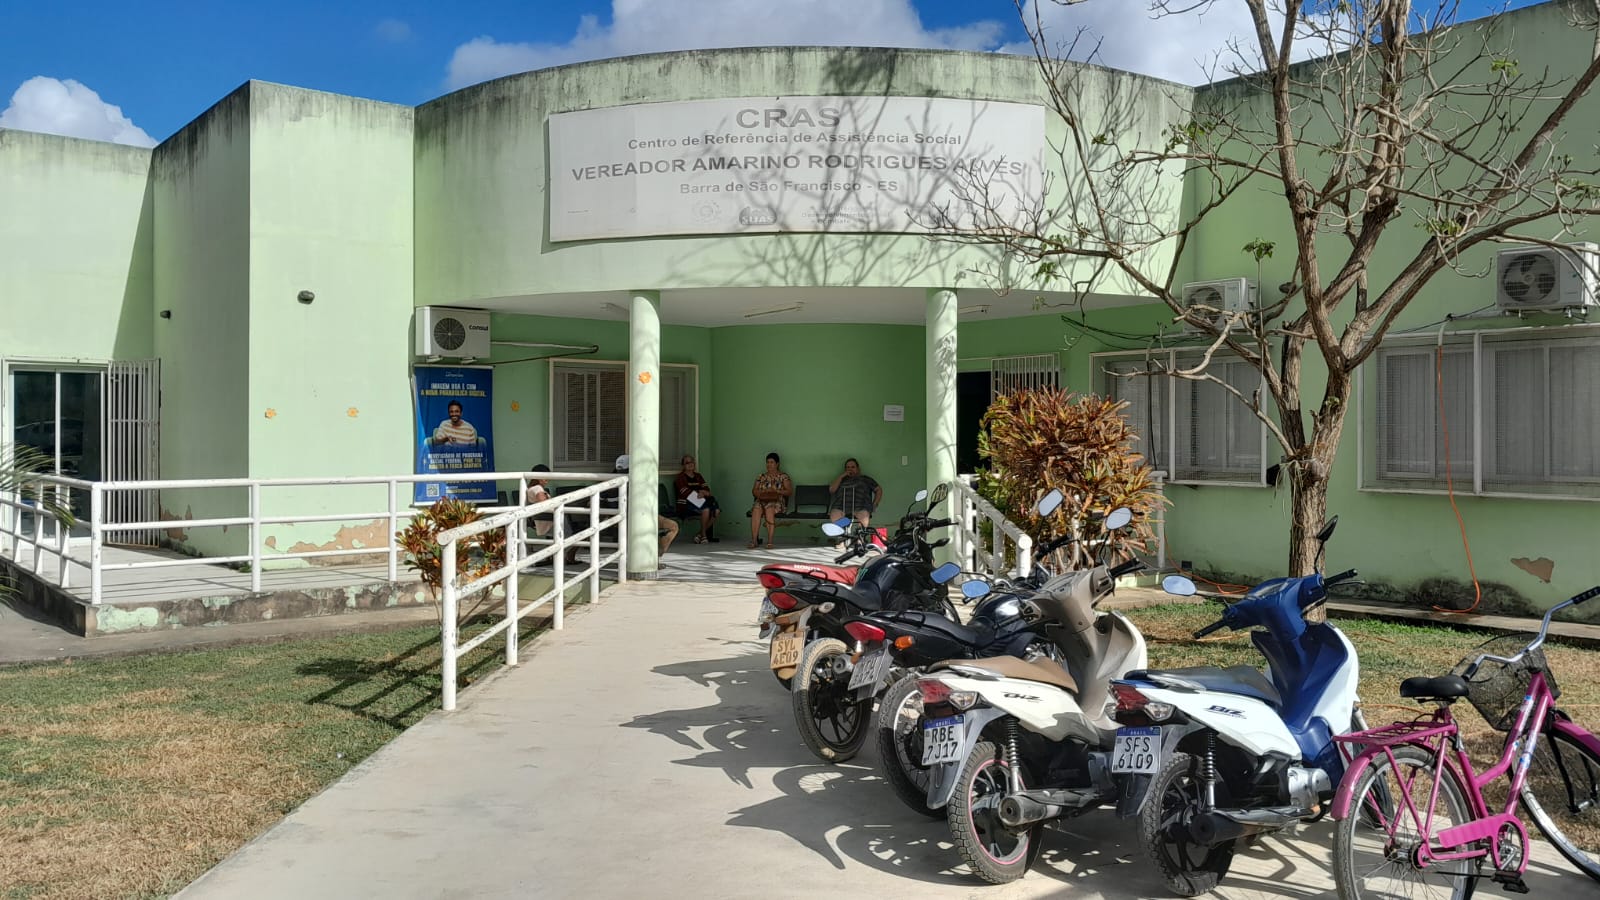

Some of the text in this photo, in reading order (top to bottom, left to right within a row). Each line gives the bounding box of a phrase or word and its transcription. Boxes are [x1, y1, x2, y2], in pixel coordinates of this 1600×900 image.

[736, 108, 840, 129] CRAS
[628, 131, 961, 150] Centro de Referência de Assistência Social
[572, 155, 1022, 181] VEREADOR AMARINO RODRIGUES ALVES
[680, 183, 720, 194] Barra
[726, 182, 744, 192] de
[749, 181, 778, 192] São
[784, 181, 861, 191] Francisco
[878, 181, 898, 191] ES
[777, 640, 796, 652] SYL
[773, 651, 799, 665] 4E09
[931, 726, 955, 743] RBE
[927, 742, 958, 760] 7J17
[1124, 737, 1151, 752] SFS
